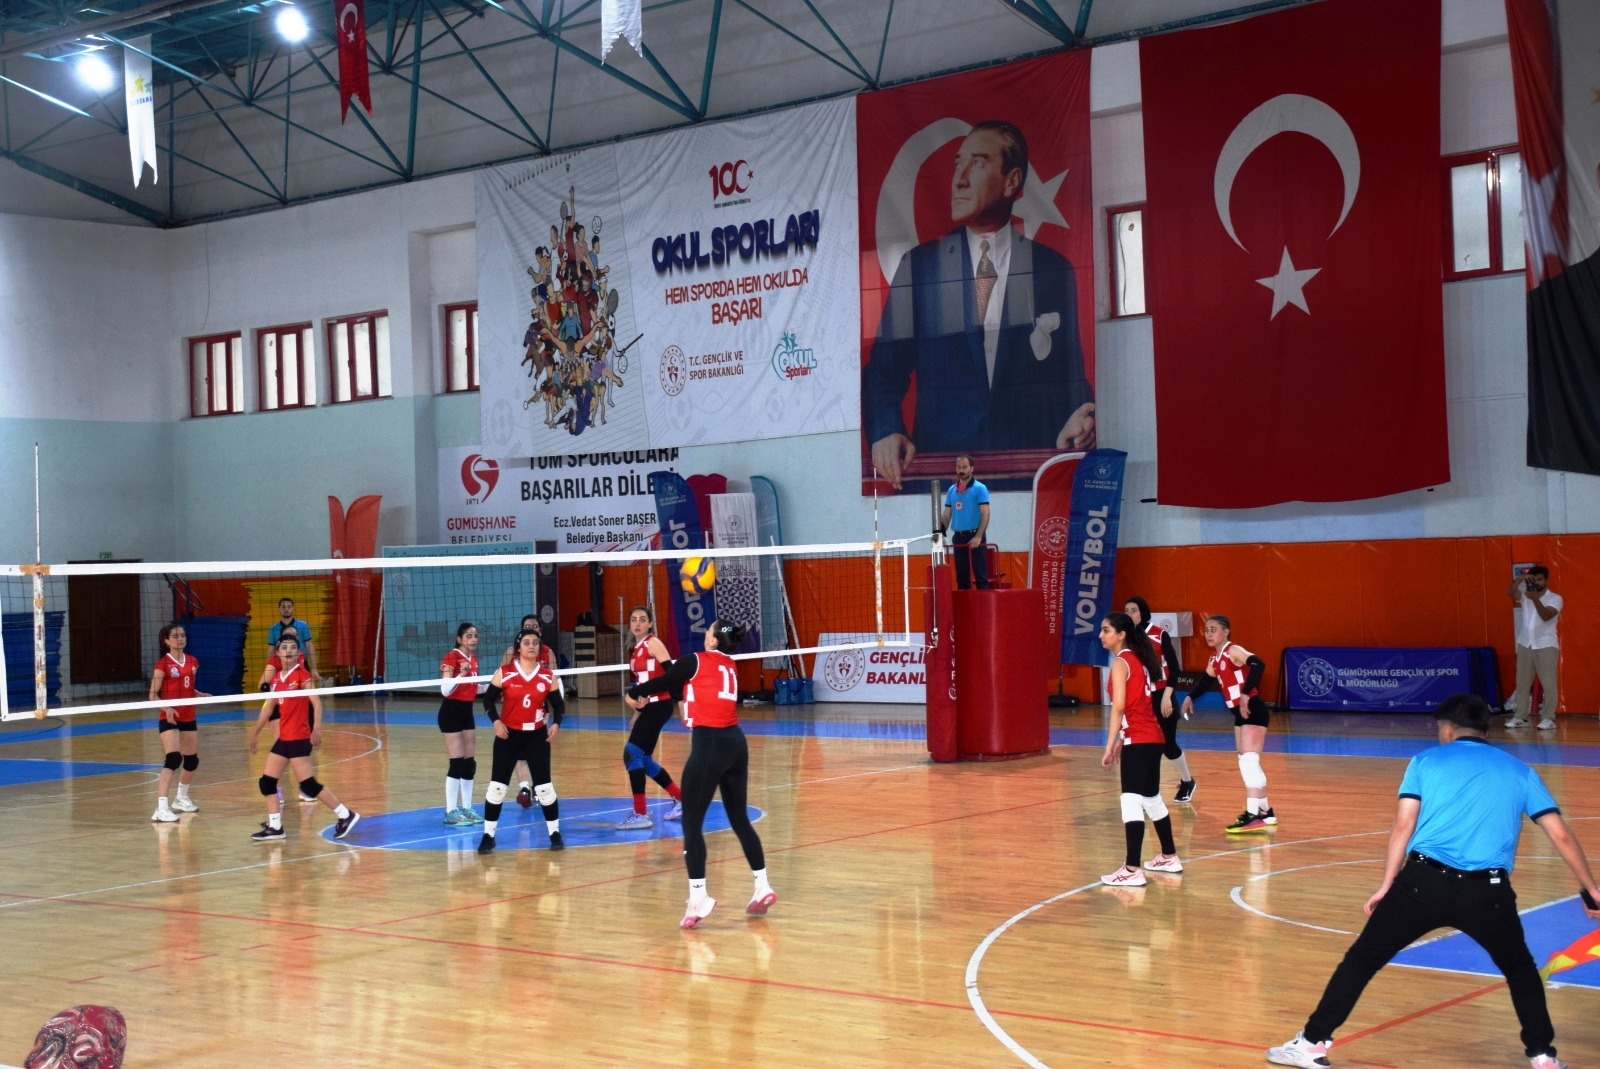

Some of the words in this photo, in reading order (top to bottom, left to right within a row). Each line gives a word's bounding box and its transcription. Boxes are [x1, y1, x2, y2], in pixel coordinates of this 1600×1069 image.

[709, 160, 750, 201] 100
[652, 231, 710, 273] OKUL
[711, 209, 820, 265] SPORLARI
[665, 285, 689, 305] HEM
[691, 280, 735, 301] SPORDA
[737, 275, 761, 295] HEM
[763, 267, 808, 290] OKULDA
[711, 297, 762, 326] BAŞARI
[689, 356, 701, 366] T.C.
[702, 352, 732, 365] GENÇLİK
[734, 351, 743, 360] VE
[778, 348, 818, 373] OKUL
[689, 369, 707, 380] SPOR
[708, 365, 744, 378] BAKANLIĞI
[567, 447, 679, 468] SPORCULARA
[521, 476, 613, 504] BAŞARILAR
[447, 515, 516, 531] GÜMÜŞHANE
[554, 515, 597, 528] Ecz.Vedat
[598, 514, 625, 526] Soner
[626, 512, 656, 527] BAŞER
[451, 534, 512, 544] BELEDİYESİ
[566, 532, 605, 545] Belediye
[607, 530, 644, 544] Başkanı
[1074, 505, 1109, 636] VOLEYBOL
[1050, 561, 1058, 597] GENÇLİK
[1050, 599, 1056, 609] VE
[1337, 668, 1389, 678] GÜMÜŞHANE
[1389, 668, 1425, 678] GENÇLİK
[1425, 668, 1436, 676] VE
[1436, 668, 1459, 676] SPOR
[184, 675, 190, 688] 8
[718, 664, 738, 702] 11
[1337, 678, 1345, 687] İL
[1346, 678, 1398, 688] MÜDÜRLÜĞÜ
[522, 693, 531, 708] 6
